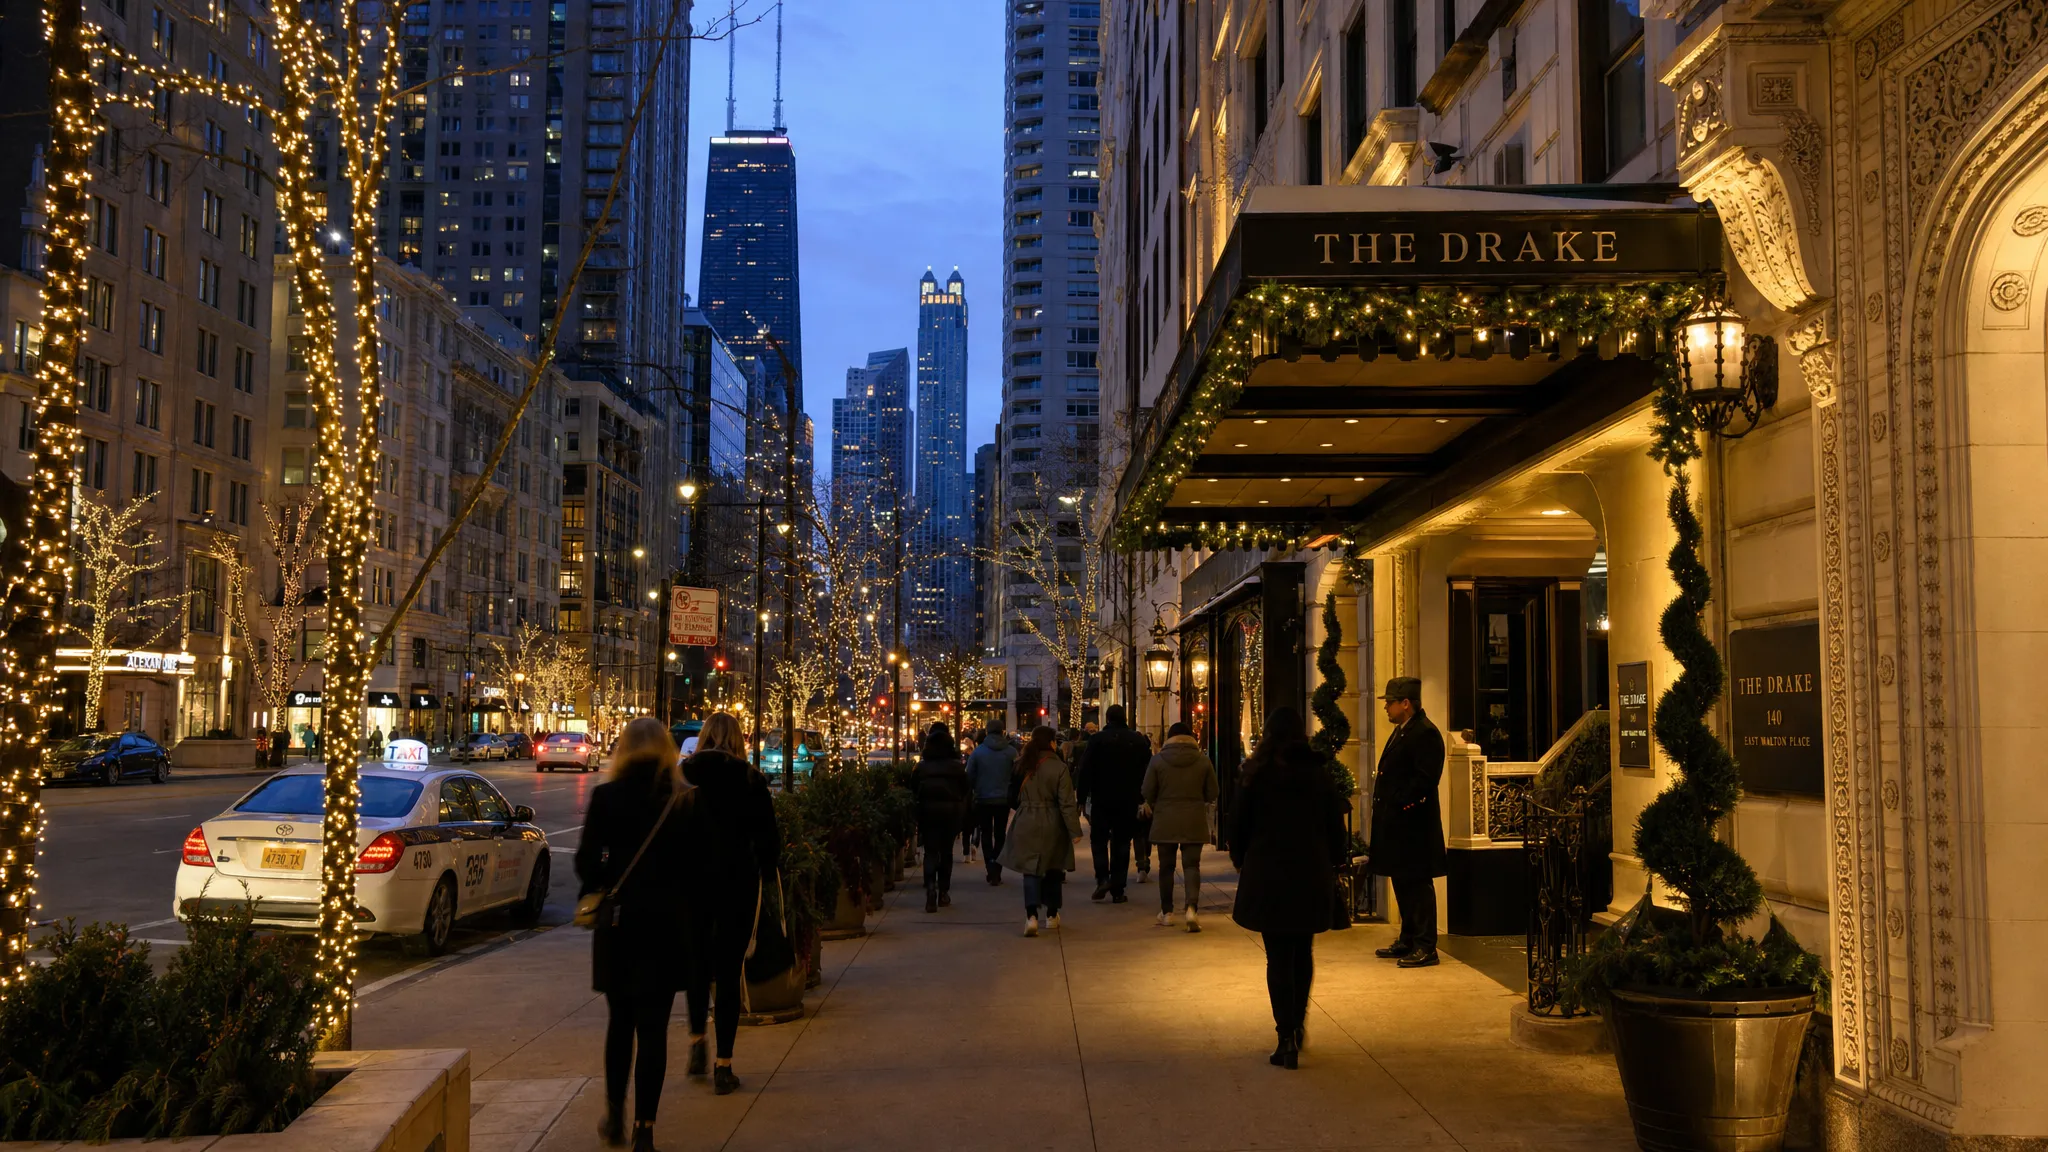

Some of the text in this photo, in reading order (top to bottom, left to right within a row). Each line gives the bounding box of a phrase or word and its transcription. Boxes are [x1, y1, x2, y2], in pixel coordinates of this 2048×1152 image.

[1313, 230, 1619, 264] THE DRAKE
[1739, 673, 1813, 695] THE DRAKE
[1767, 709, 1782, 726] 140
[1744, 736, 1811, 747] EAST WALTON PLACE
[388, 745, 423, 760] TAXI
[265, 853, 287, 865] 4730
[290, 854, 301, 866] TX
[413, 850, 433, 870] 4730
